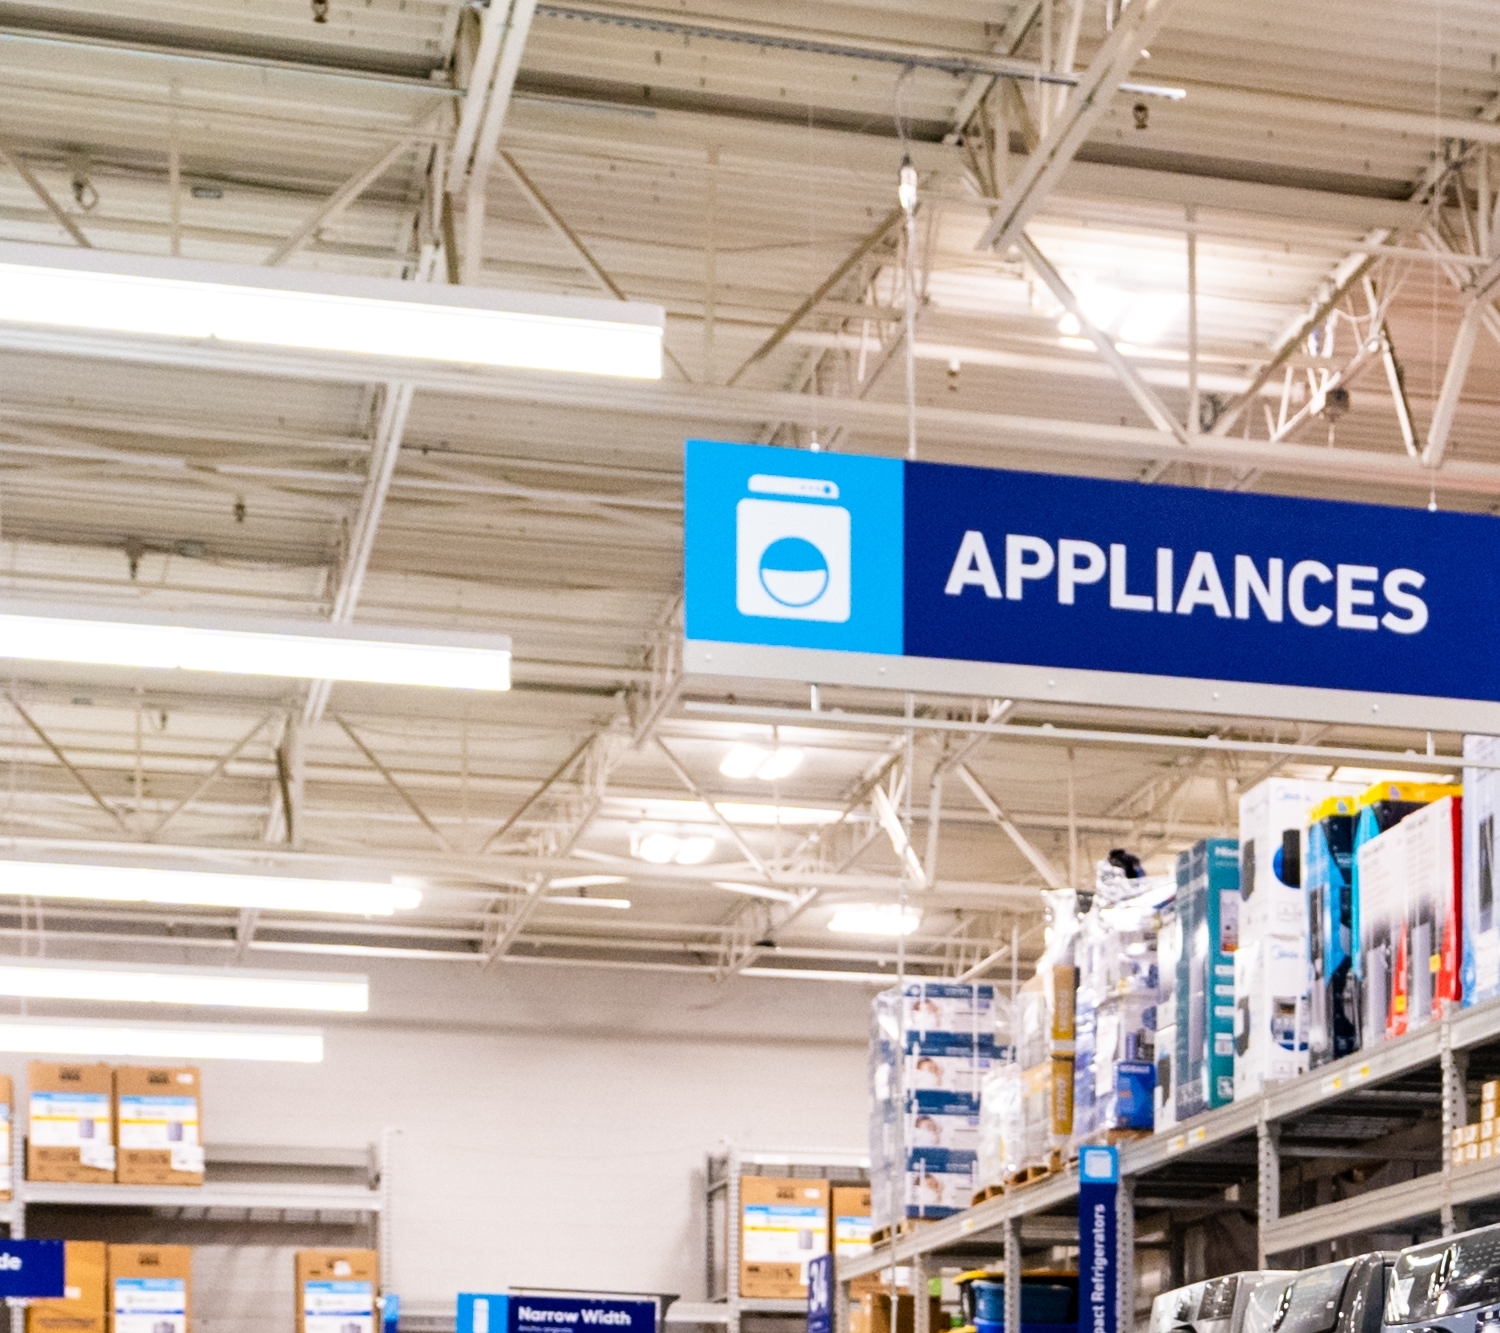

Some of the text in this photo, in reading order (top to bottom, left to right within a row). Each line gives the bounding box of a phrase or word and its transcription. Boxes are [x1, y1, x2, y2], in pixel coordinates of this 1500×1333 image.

[945, 530, 1429, 635] APPLIANCES
[1089, 1202, 1109, 1301] Refrigerators
[518, 1306, 632, 1326] Narrow Width
